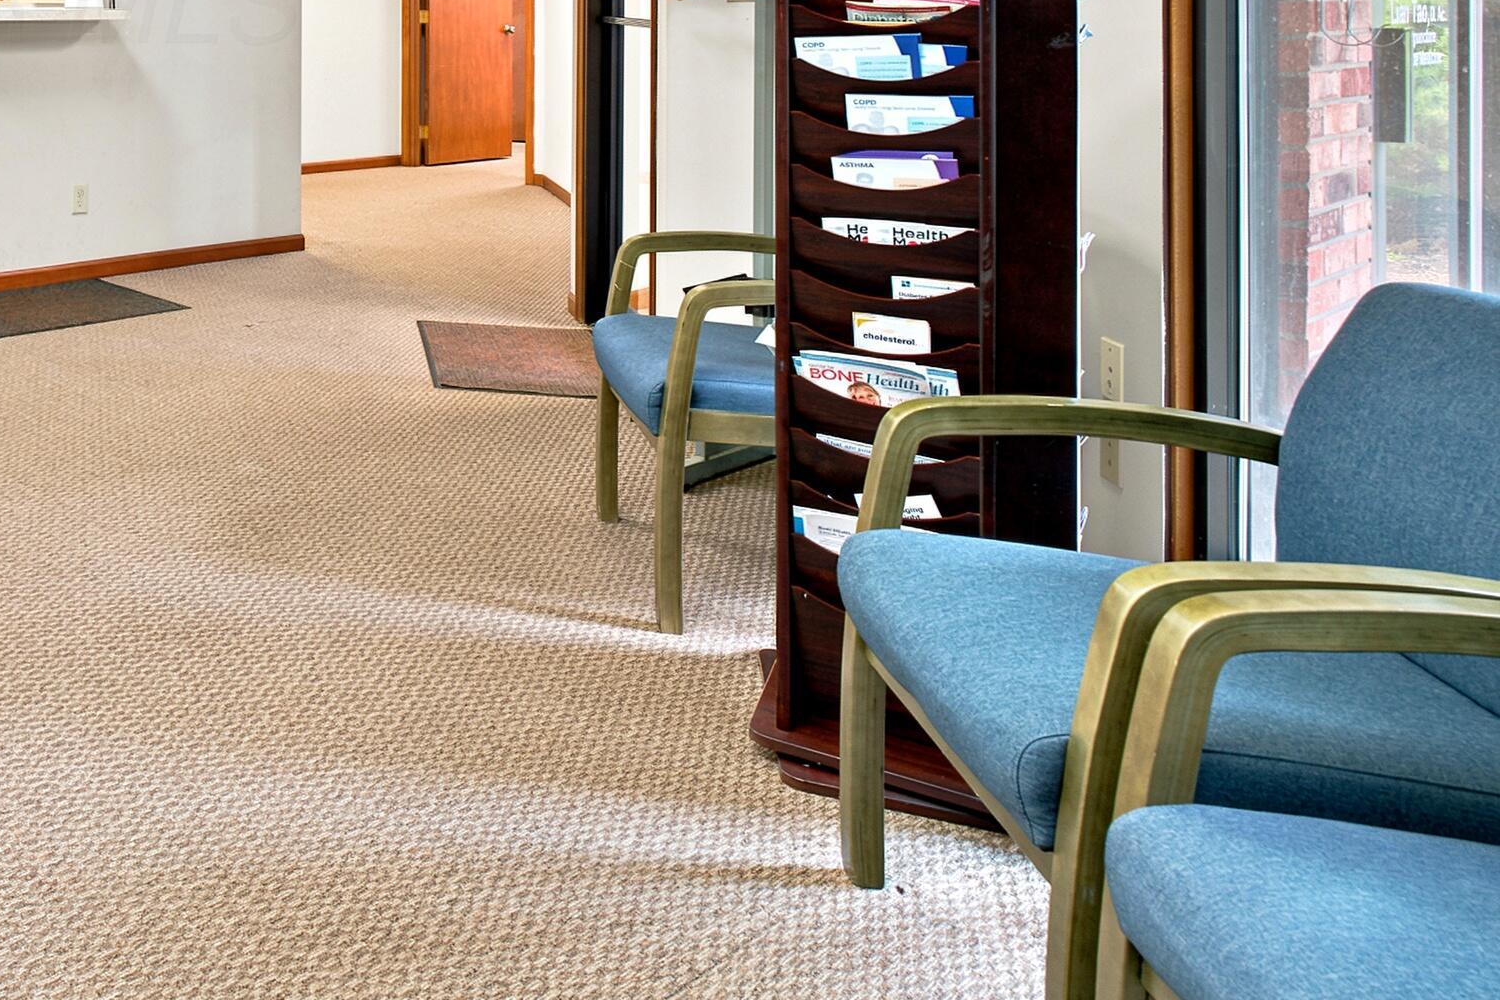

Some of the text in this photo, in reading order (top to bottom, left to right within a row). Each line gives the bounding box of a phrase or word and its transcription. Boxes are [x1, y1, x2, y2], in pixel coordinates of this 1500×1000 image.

[839, 161, 875, 169] ASTHMA
[892, 226, 949, 241] Health
[809, 367, 920, 392] BONE Health
